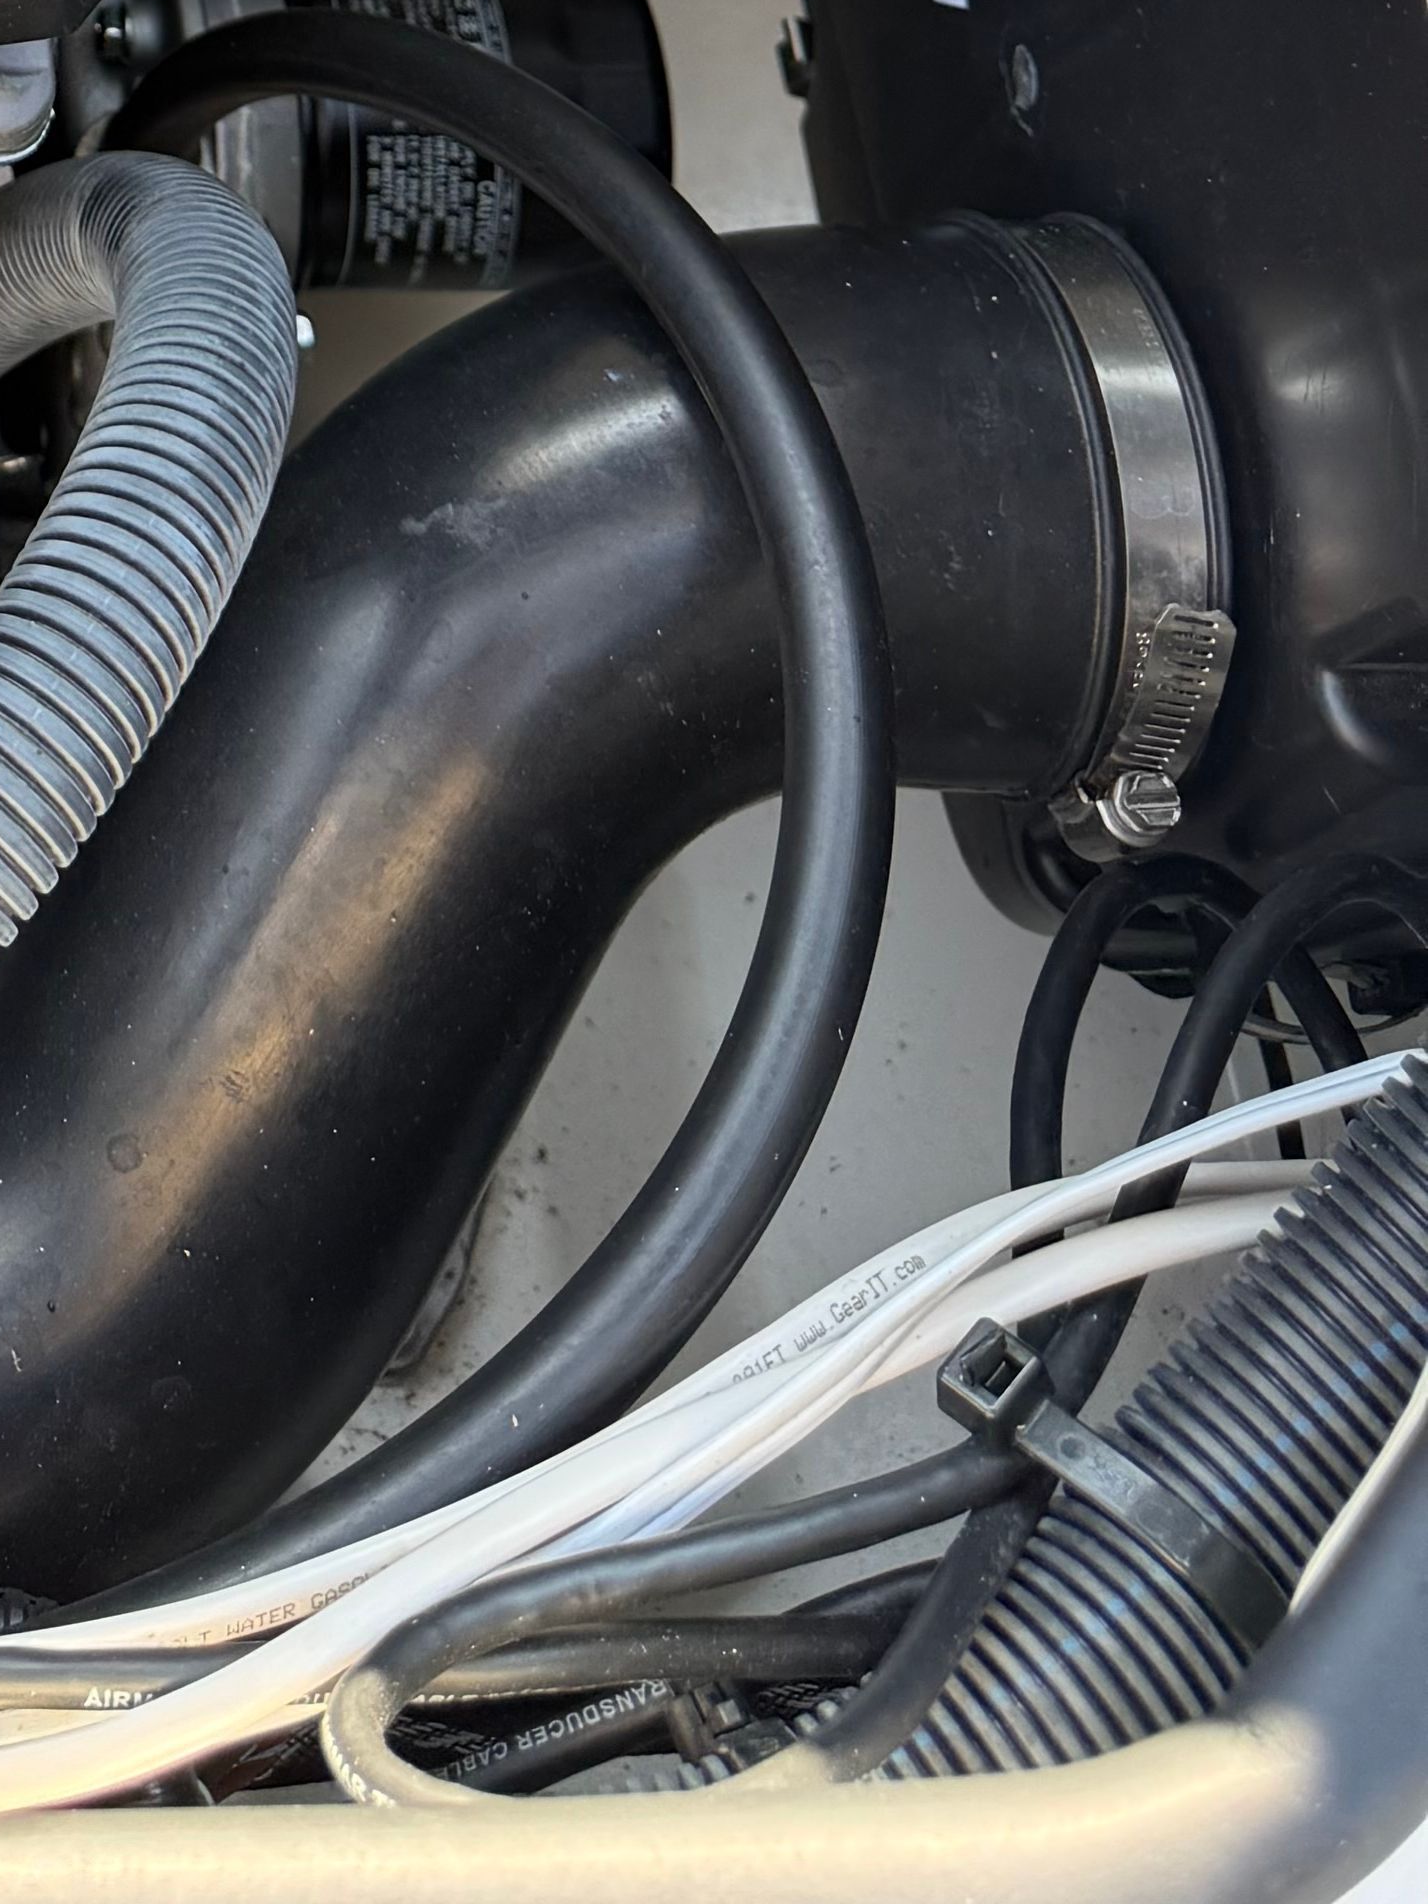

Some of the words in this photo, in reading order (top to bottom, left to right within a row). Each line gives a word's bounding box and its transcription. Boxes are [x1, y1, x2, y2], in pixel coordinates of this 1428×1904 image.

[792, 1253, 929, 1353] www.GearIT.com
[226, 1602, 298, 1638] WATER
[517, 1678, 672, 1750] RANSDUCER
